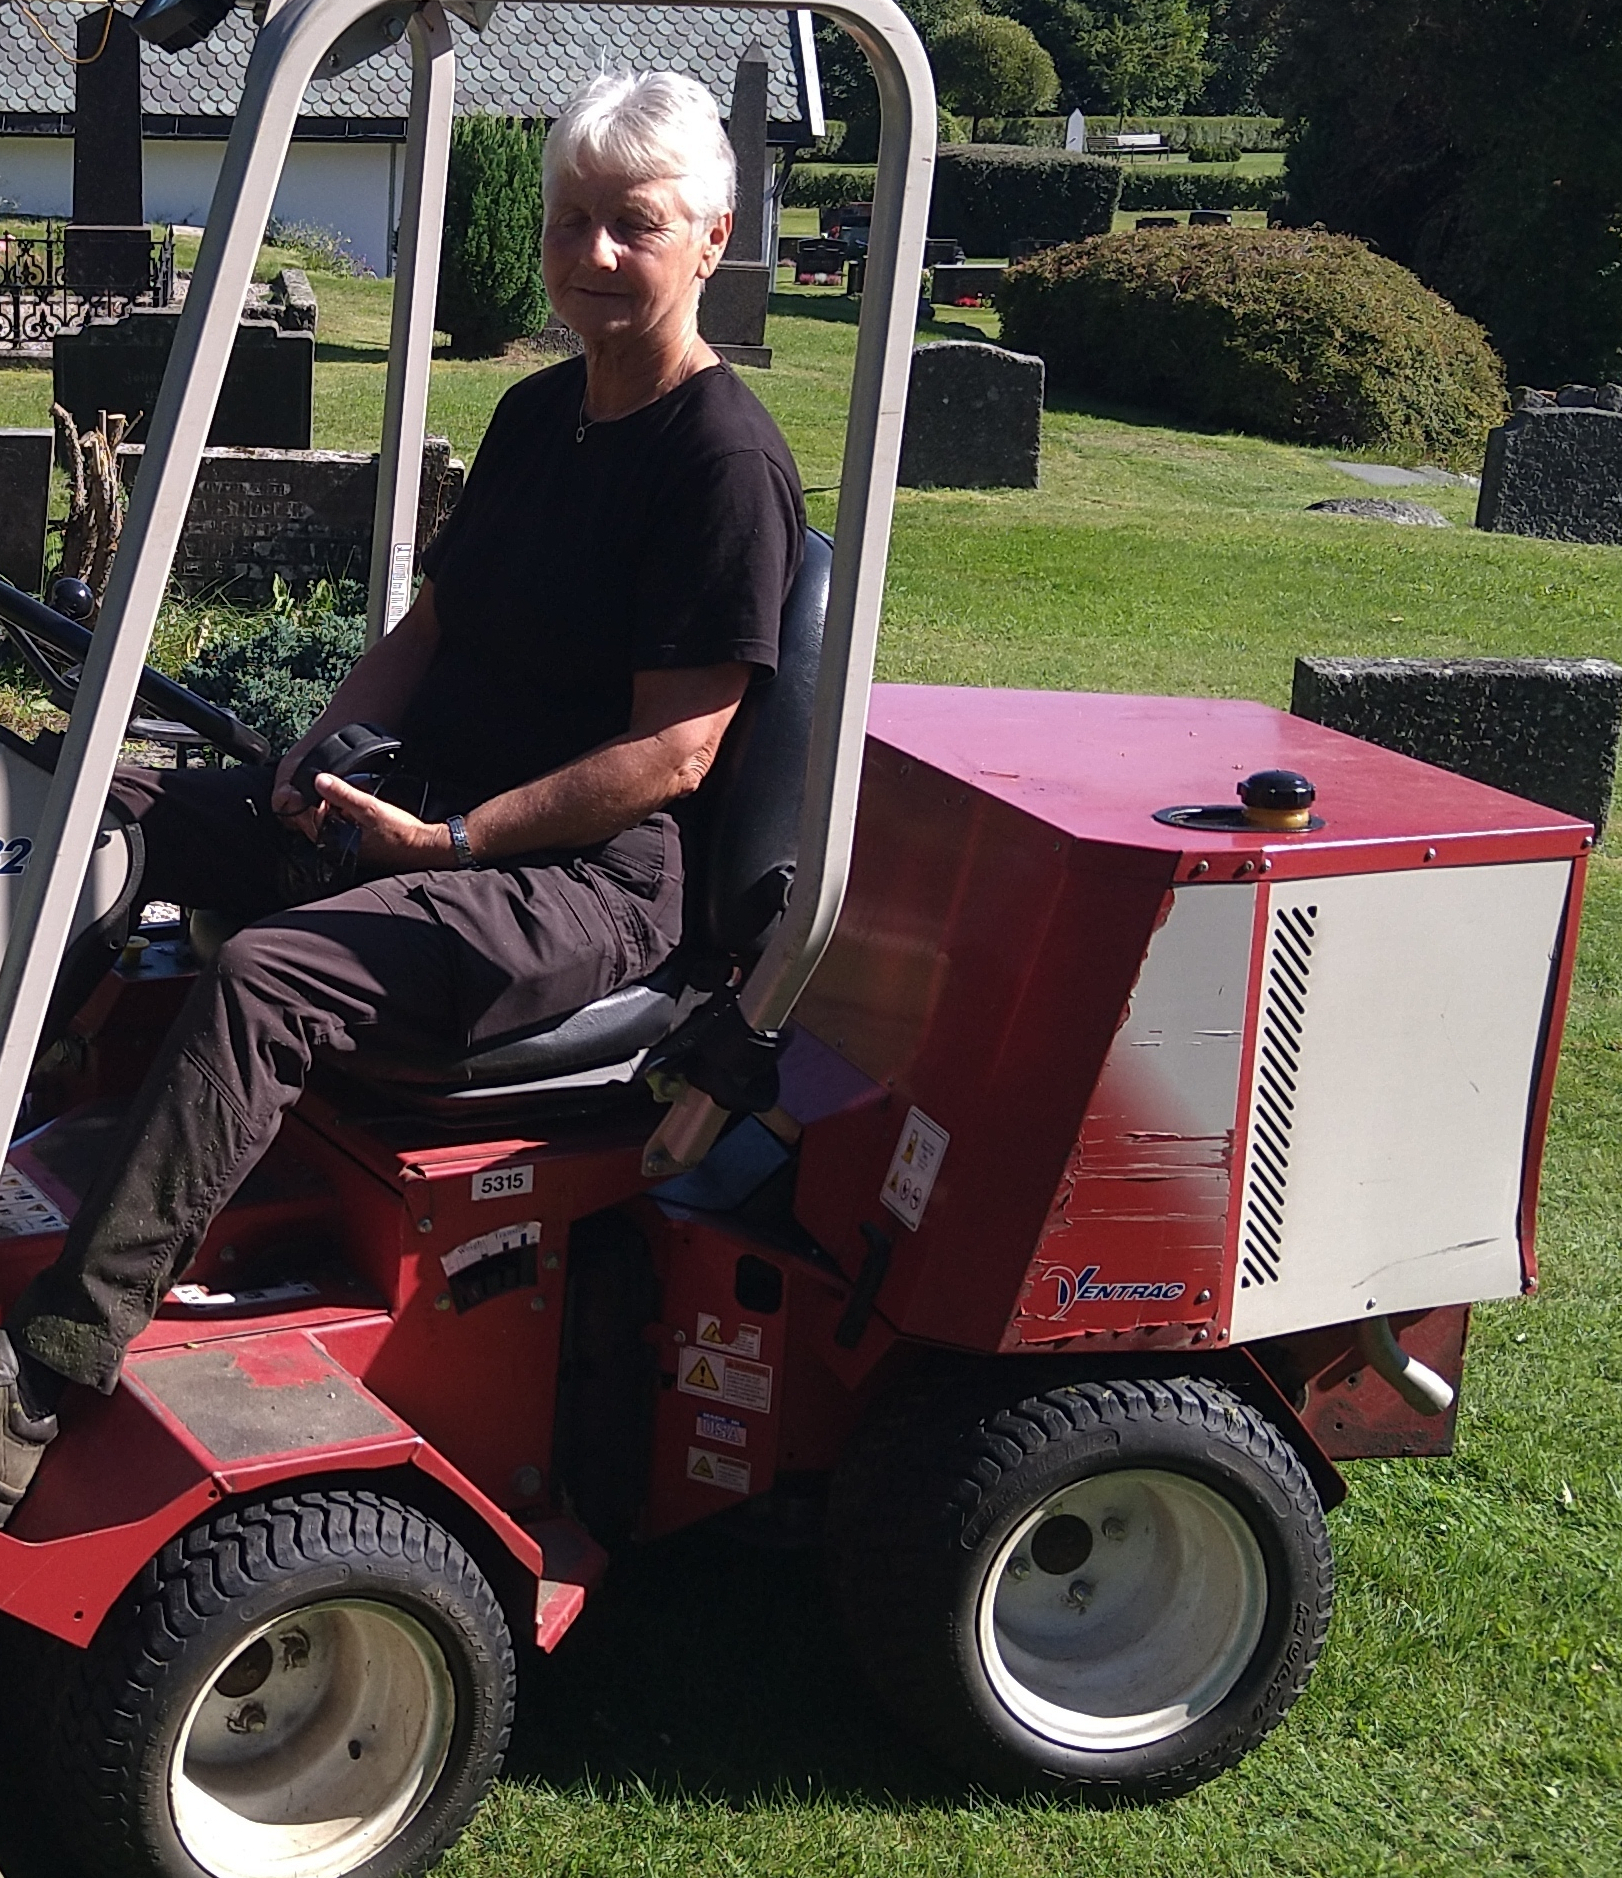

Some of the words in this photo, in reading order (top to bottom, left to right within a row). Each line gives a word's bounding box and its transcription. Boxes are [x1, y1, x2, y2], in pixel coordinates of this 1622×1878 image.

[481, 1172, 524, 1194] 5315
[1040, 1265, 1187, 1321] VENTRAC
[701, 1416, 743, 1442] USA
